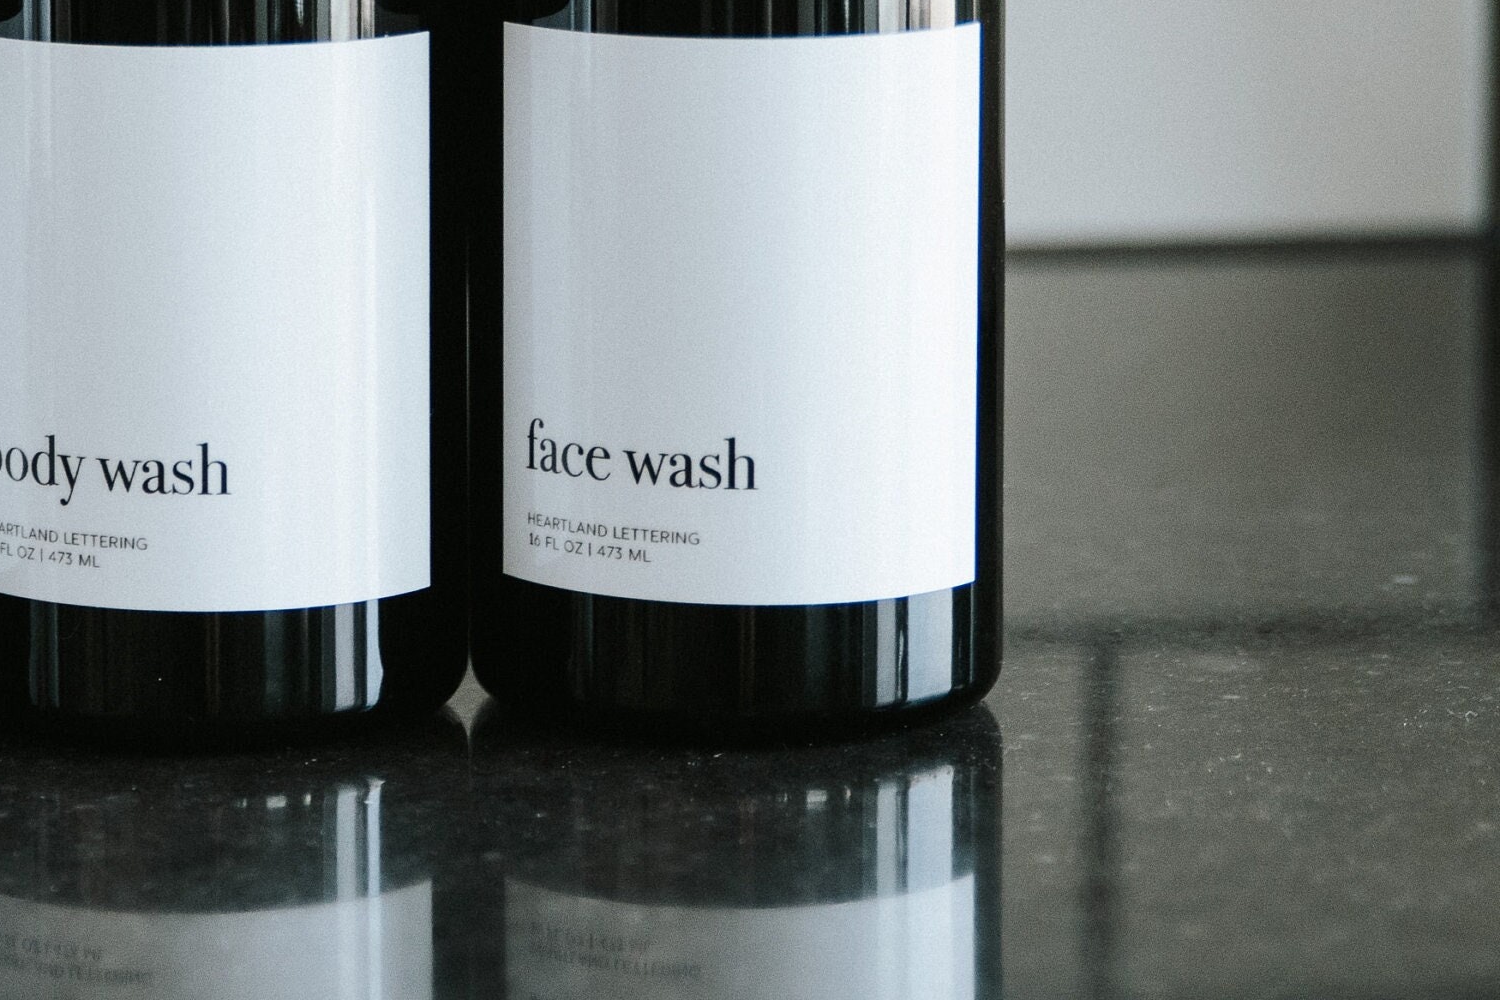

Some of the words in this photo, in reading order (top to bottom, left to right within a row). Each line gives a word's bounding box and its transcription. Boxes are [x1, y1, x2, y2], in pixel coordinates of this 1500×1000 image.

[94, 441, 232, 496] wash
[525, 417, 612, 482] face
[621, 435, 759, 491] wash
[64, 532, 149, 551] LETTERING
[528, 512, 609, 538] HEARTLAND
[613, 526, 701, 546] LETTERING
[0, 542, 13, 557] FL
[17, 545, 36, 561] OZ
[48, 550, 74, 566] 473
[79, 554, 101, 569] ML
[529, 532, 541, 547] 16
[545, 536, 559, 551] FL
[564, 539, 584, 555] OZ
[597, 545, 623, 561] 473
[629, 548, 652, 563] ML
